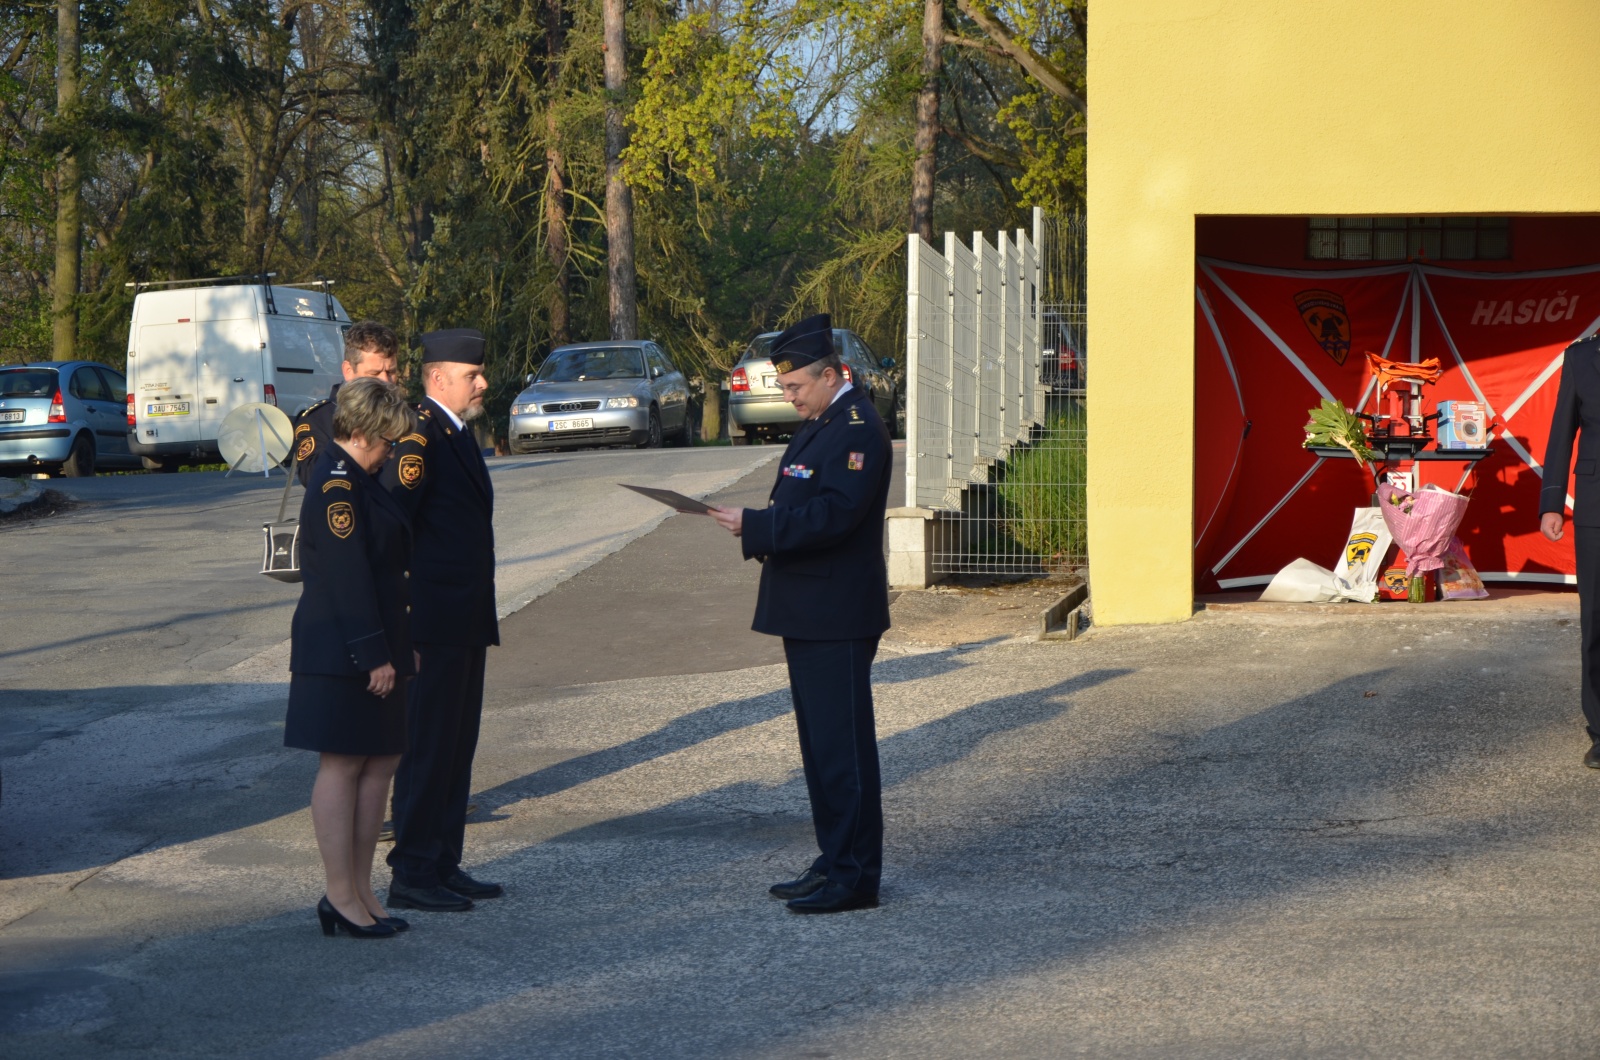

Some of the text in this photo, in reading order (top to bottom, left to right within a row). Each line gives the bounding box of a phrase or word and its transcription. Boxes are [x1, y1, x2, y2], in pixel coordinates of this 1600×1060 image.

[1470, 290, 1580, 326] HASIČI
[153, 403, 186, 413] 3AU 7545
